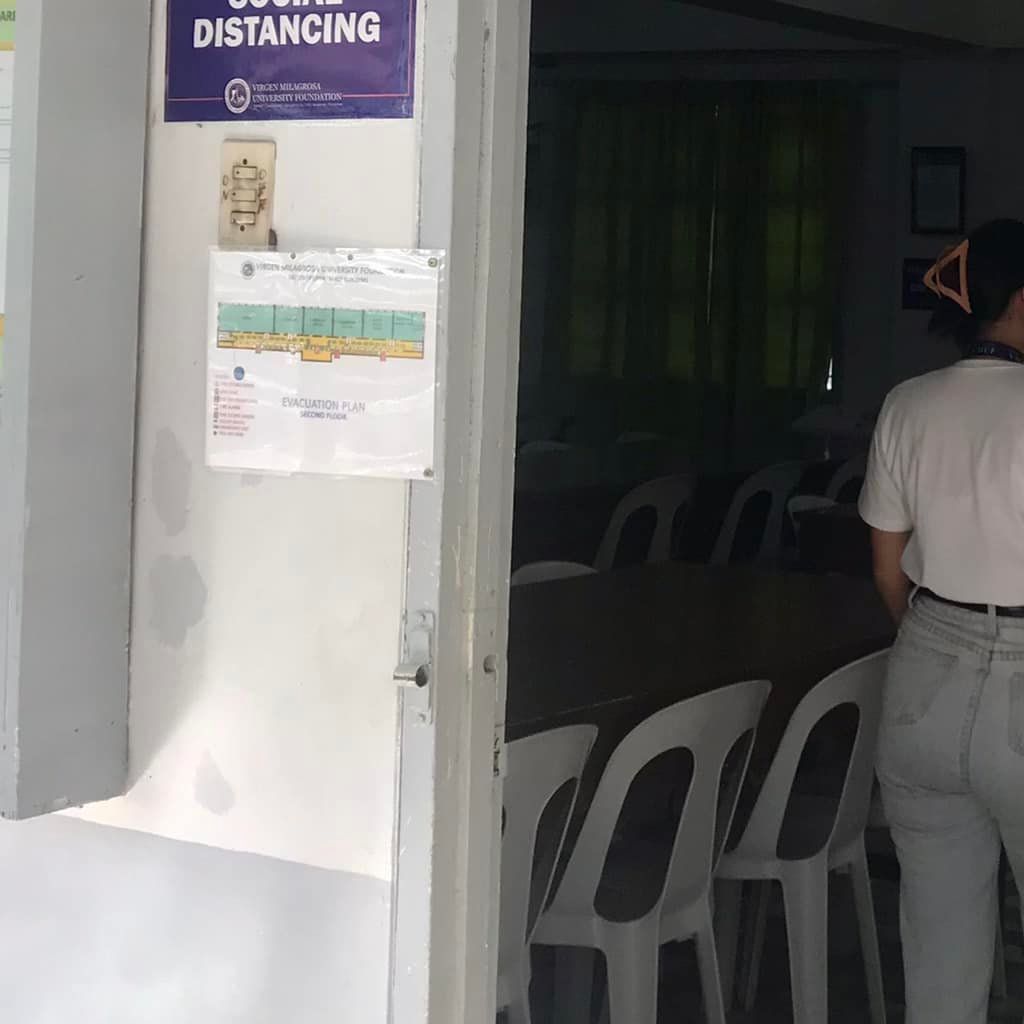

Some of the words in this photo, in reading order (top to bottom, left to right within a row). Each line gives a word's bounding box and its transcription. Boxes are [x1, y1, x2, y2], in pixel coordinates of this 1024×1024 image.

[193, 11, 381, 48] DISTANCING
[252, 83, 279, 91] VIRGEN
[280, 82, 321, 91] MILAGROSA
[252, 94, 294, 103] UNIVERSITY
[294, 92, 343, 102] FOUNDATION
[282, 397, 339, 410] EVACUATION
[342, 401, 366, 413] PLAN
